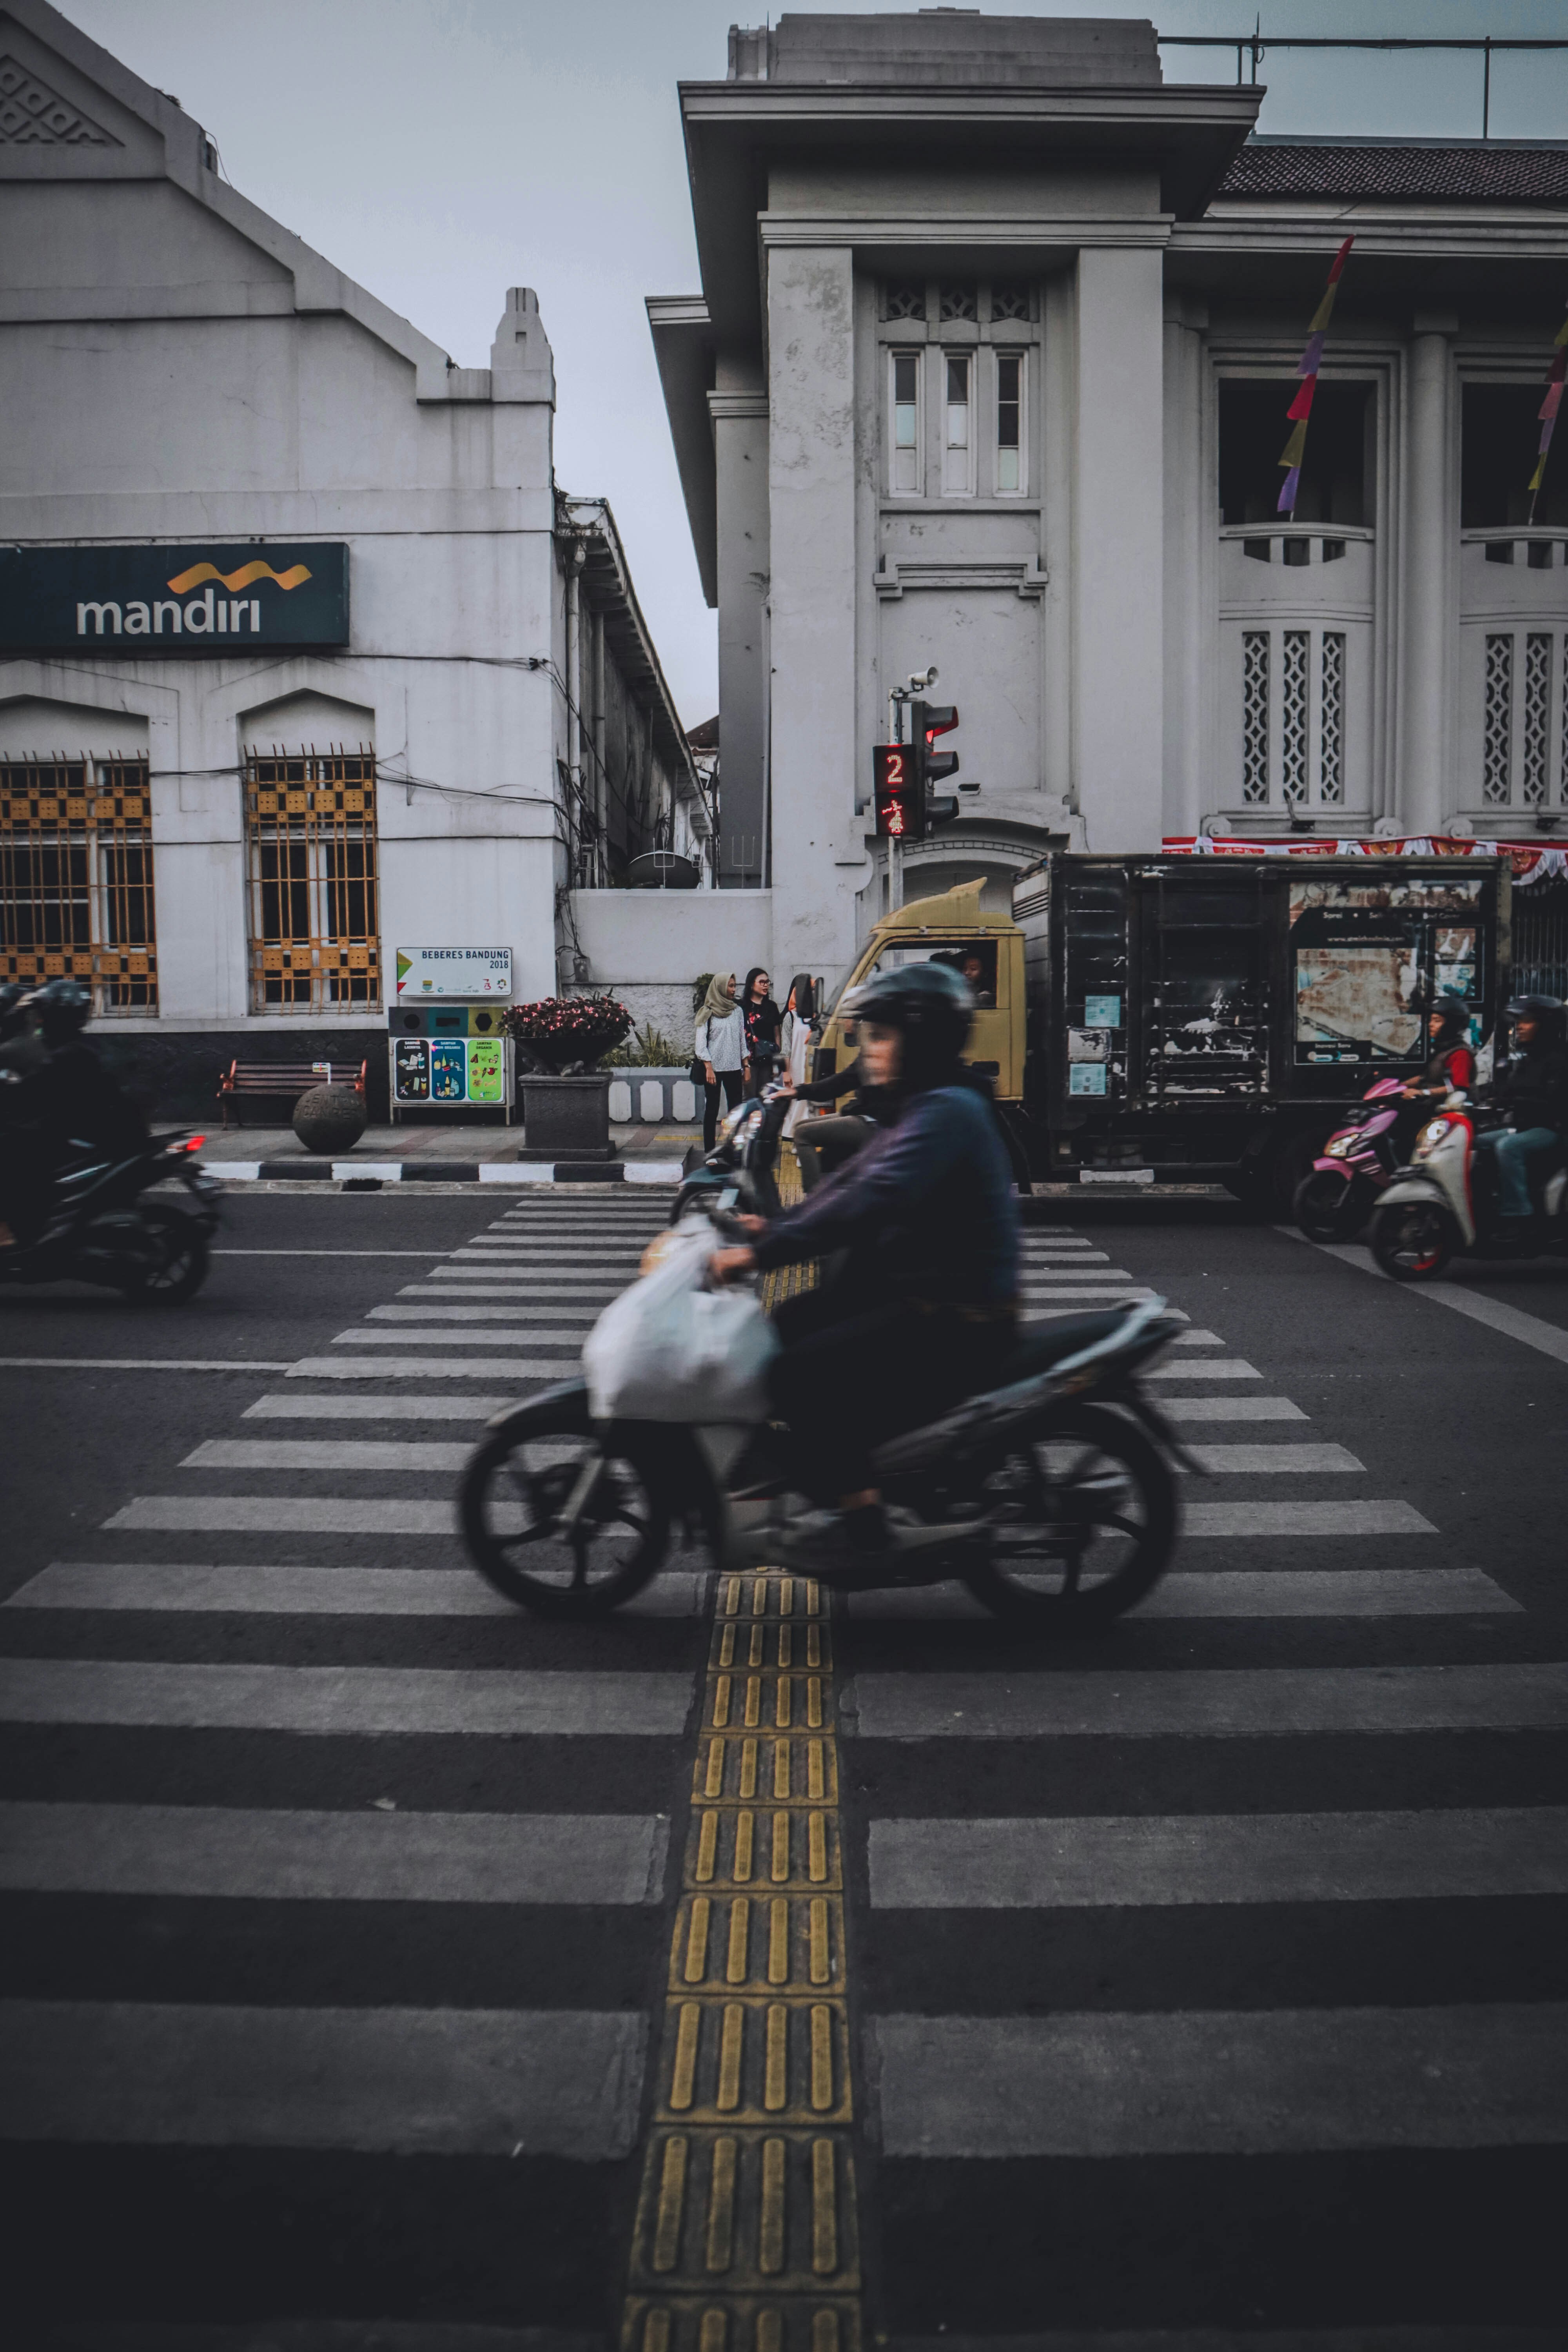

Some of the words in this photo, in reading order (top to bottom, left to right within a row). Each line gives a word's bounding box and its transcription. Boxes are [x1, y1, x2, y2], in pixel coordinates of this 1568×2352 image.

[76, 588, 260, 634] mandiri
[887, 755, 902, 782] 2
[422, 951, 463, 959] BEBERES
[466, 951, 508, 959] BANDUNG
